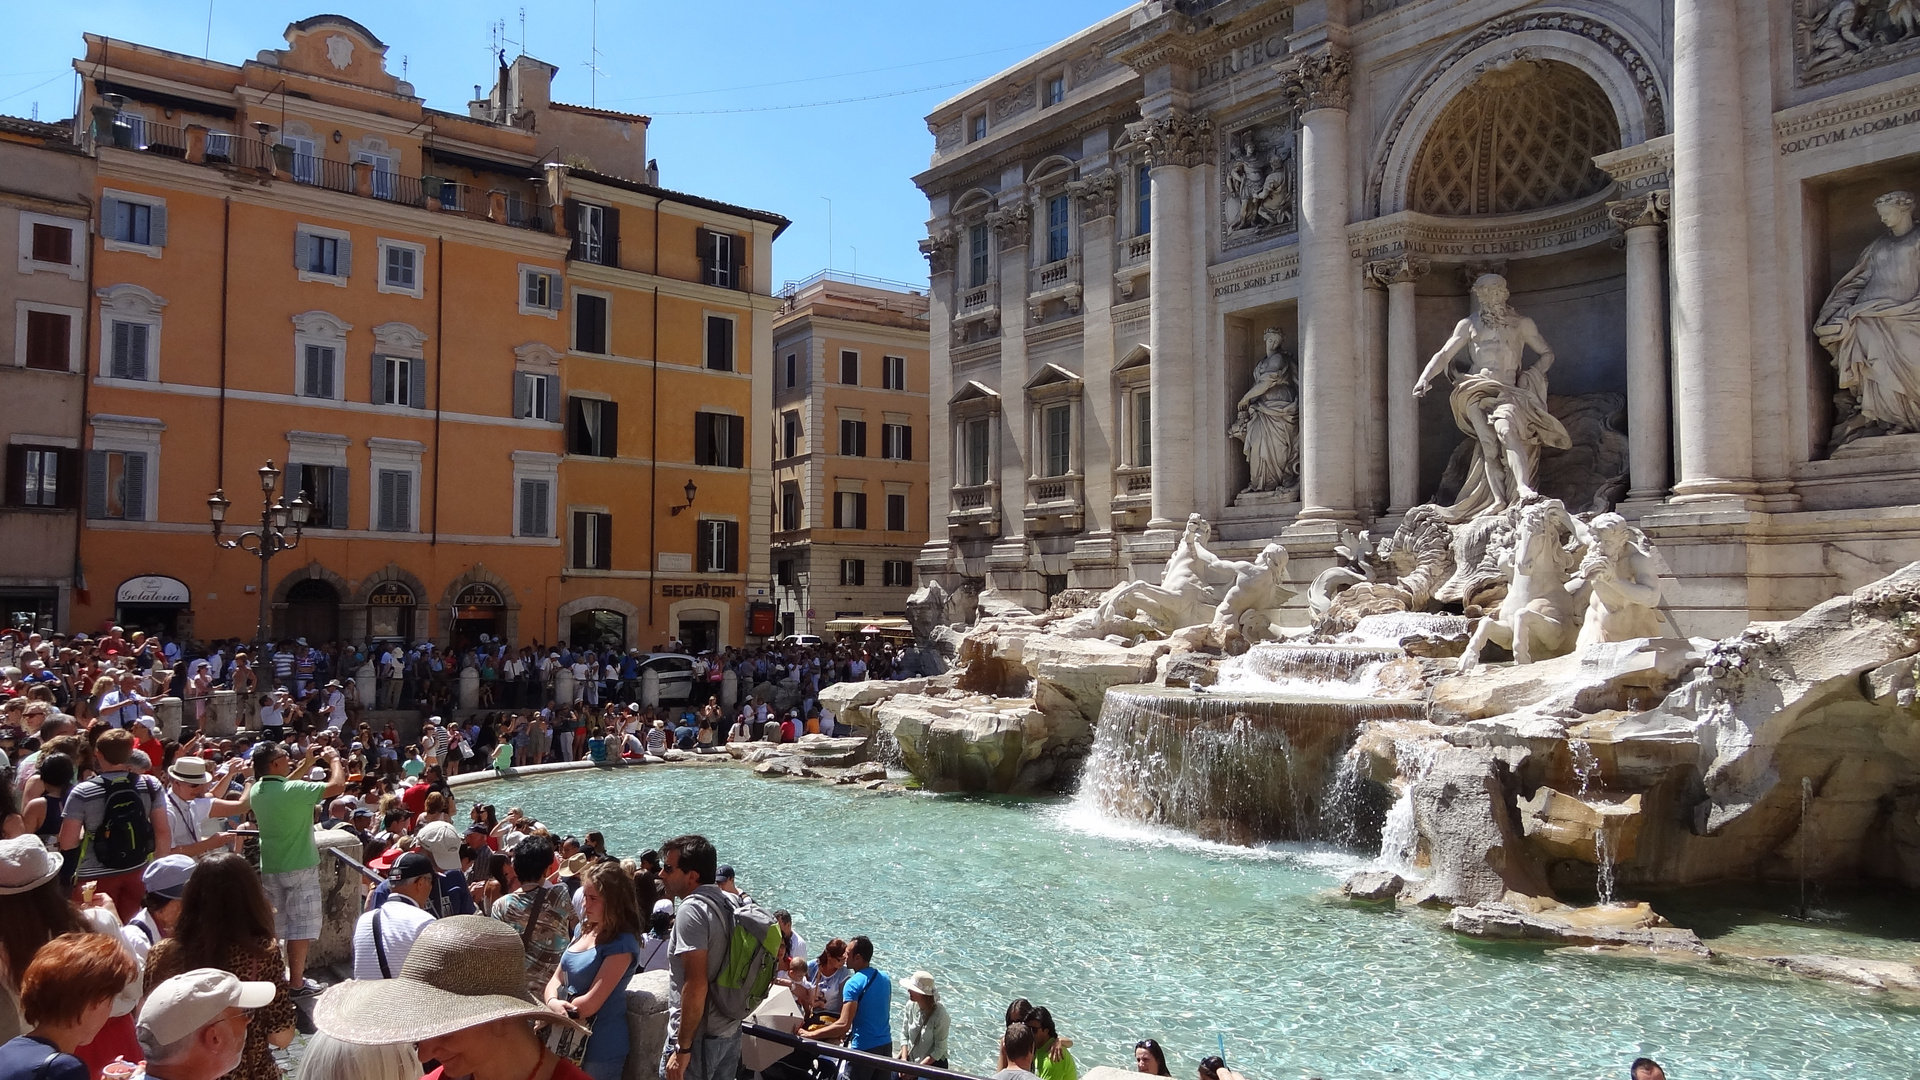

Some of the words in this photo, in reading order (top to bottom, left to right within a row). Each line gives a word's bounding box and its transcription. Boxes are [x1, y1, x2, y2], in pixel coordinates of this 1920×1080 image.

[1780, 130, 1845, 155] SOLVTVM
[1864, 115, 1898, 135] DOM
[1472, 235, 1553, 254] CLEMENTIS
[1214, 282, 1240, 297] POSITIS
[1243, 276, 1266, 289] SIGNIS
[1270, 272, 1280, 282] ET
[121, 590, 181, 601] Gelateria
[662, 582, 736, 598] SEGATORI
[372, 594, 412, 604] GELATI
[464, 595, 497, 604] PIZZA
